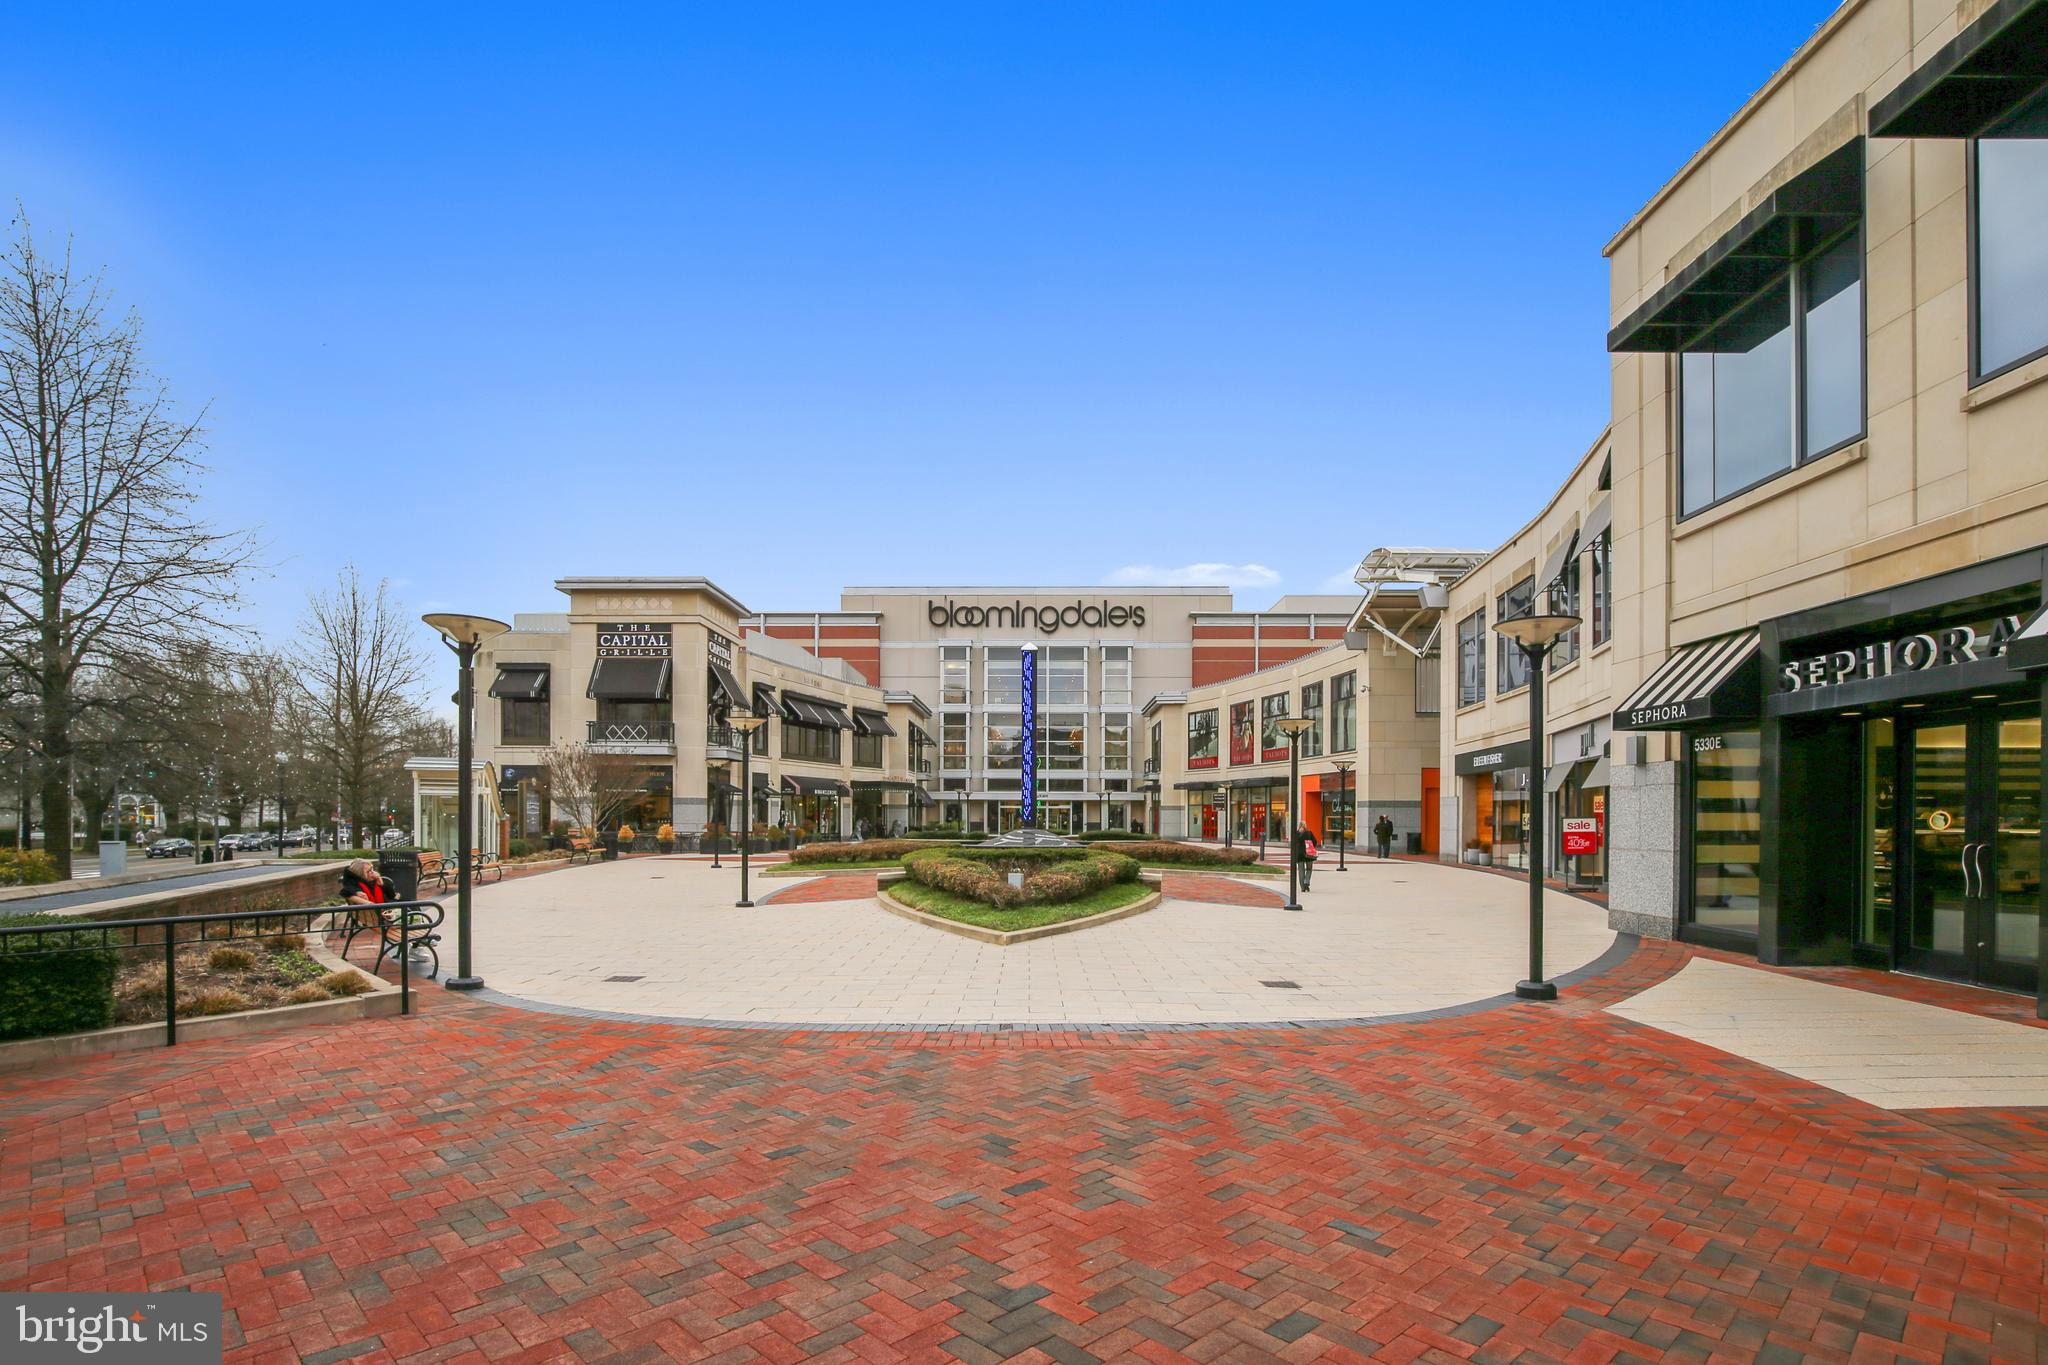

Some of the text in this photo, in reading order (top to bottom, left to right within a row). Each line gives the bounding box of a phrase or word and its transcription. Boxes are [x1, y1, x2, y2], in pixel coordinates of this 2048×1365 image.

[928, 600, 1146, 634] bloomingdale's
[617, 624, 651, 632] THE
[600, 635, 668, 647] CAPITAL
[1777, 615, 2022, 693] SEPHORA
[1631, 704, 1687, 725] SEPHORA
[1694, 736, 1722, 752] 5330E
[1567, 820, 1590, 830] sale
